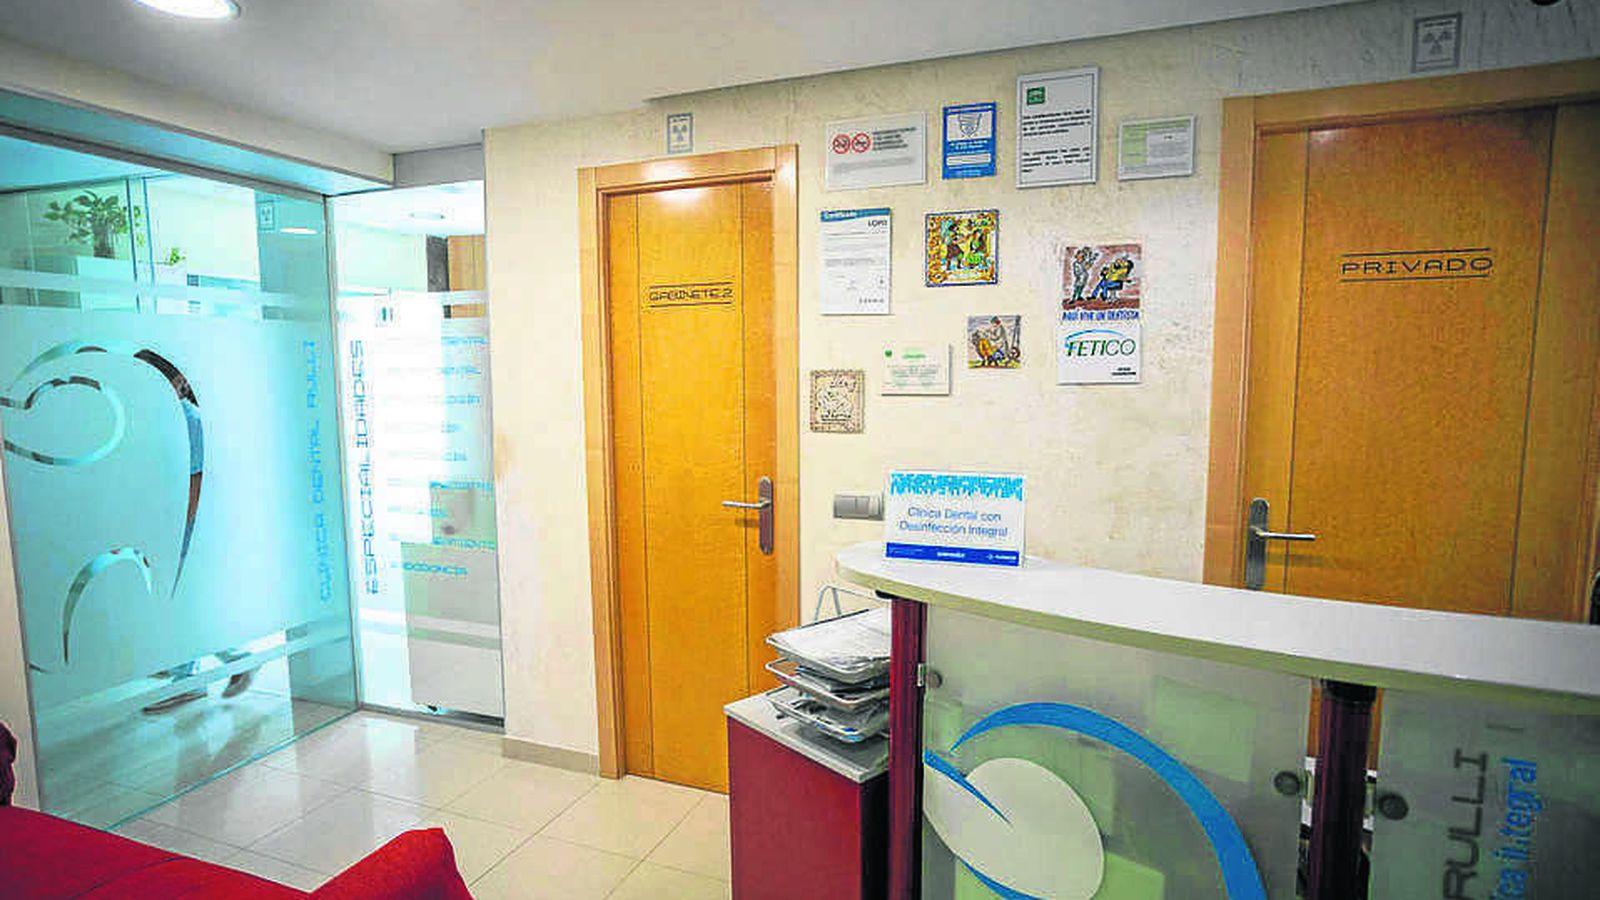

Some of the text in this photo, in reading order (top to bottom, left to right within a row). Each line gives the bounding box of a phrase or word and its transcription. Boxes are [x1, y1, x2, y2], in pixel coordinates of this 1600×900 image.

[1342, 256, 1494, 275] PRIVADO
[649, 287, 720, 301] GABINETE
[1064, 337, 1136, 357] FETICO
[350, 340, 379, 595] ESPECIALIDADES
[945, 508, 978, 521] Dental
[981, 511, 1002, 523] con
[968, 525, 1009, 538] Integral
[1493, 757, 1543, 863] integral
